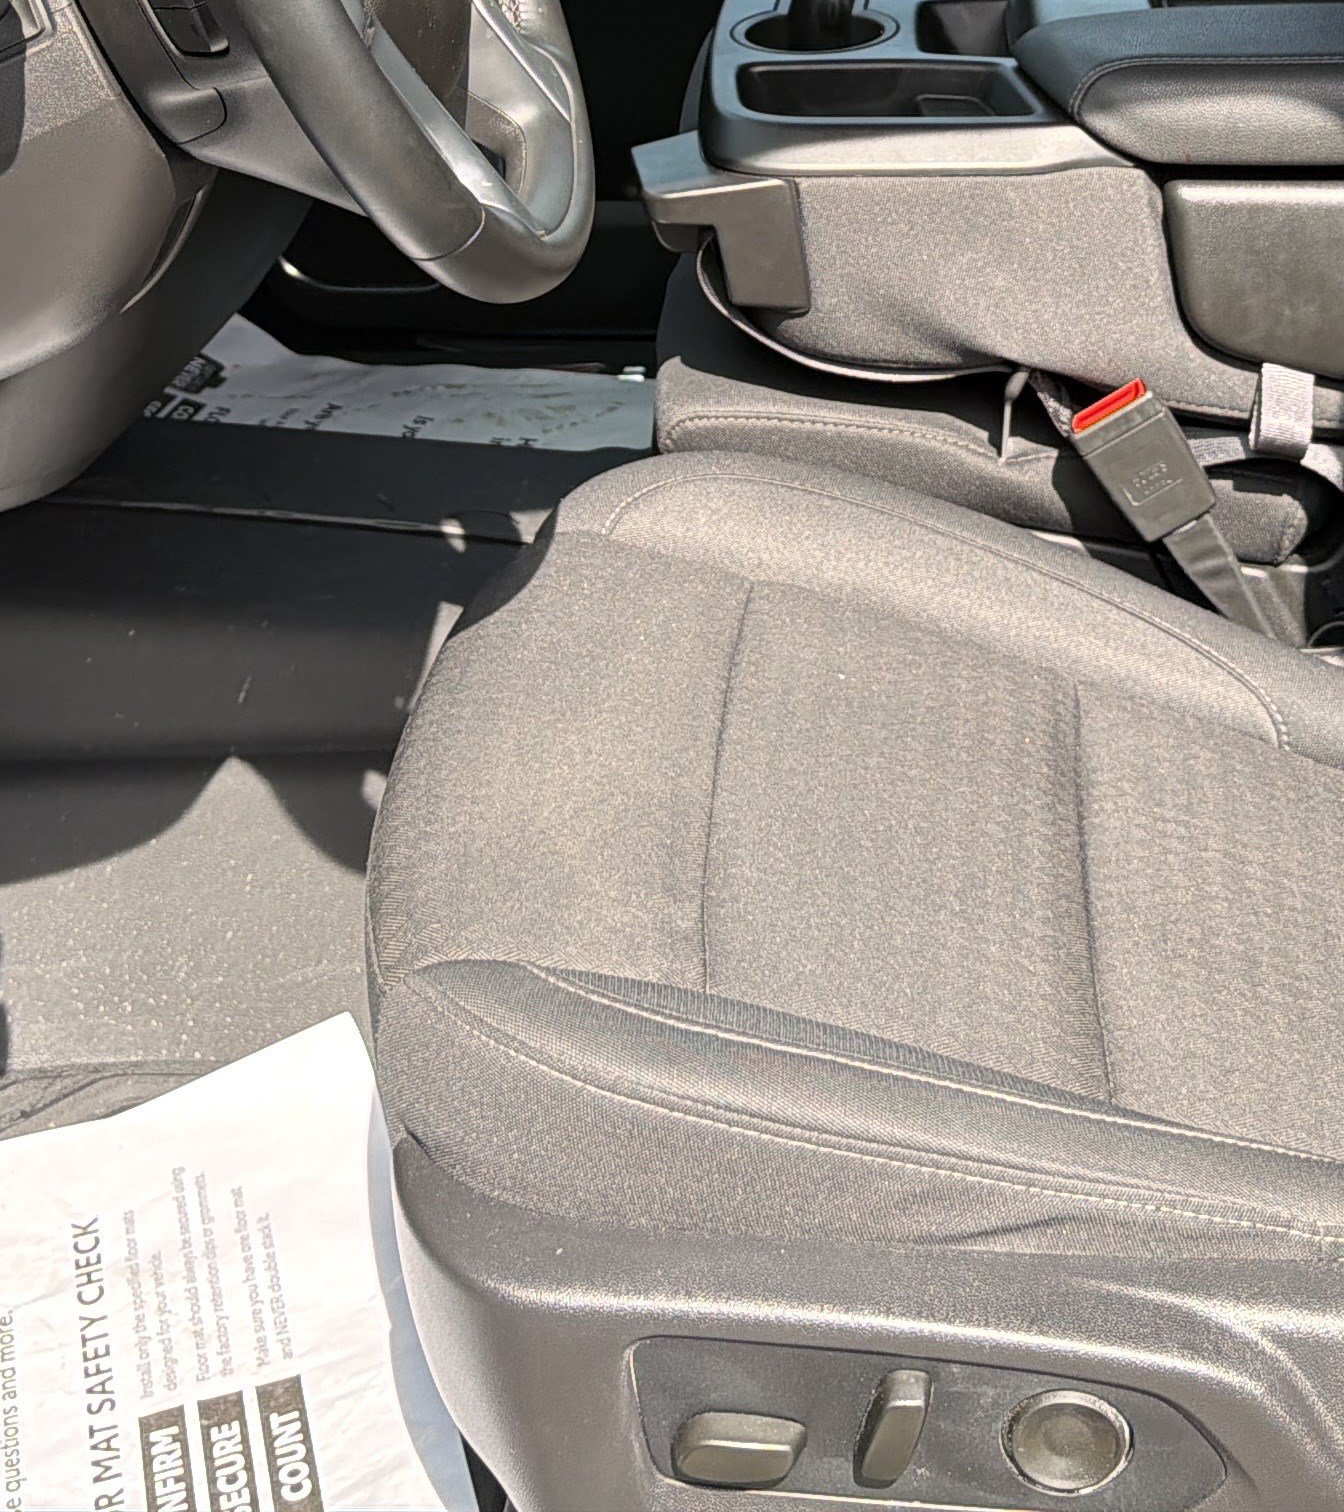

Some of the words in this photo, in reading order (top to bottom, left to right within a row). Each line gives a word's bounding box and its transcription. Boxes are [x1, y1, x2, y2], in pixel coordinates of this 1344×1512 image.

[71, 1216, 105, 1306] CHECK
[133, 1313, 147, 1334] the
[155, 1291, 173, 1317] your
[156, 1318, 170, 1336] for
[270, 1293, 290, 1336] NEVER
[78, 1314, 116, 1416] SAFETY
[158, 1336, 178, 1391] designed
[88, 1424, 123, 1485] MAT
[148, 1424, 189, 1512] NFIRM
[269, 1409, 313, 1502] COUNT
